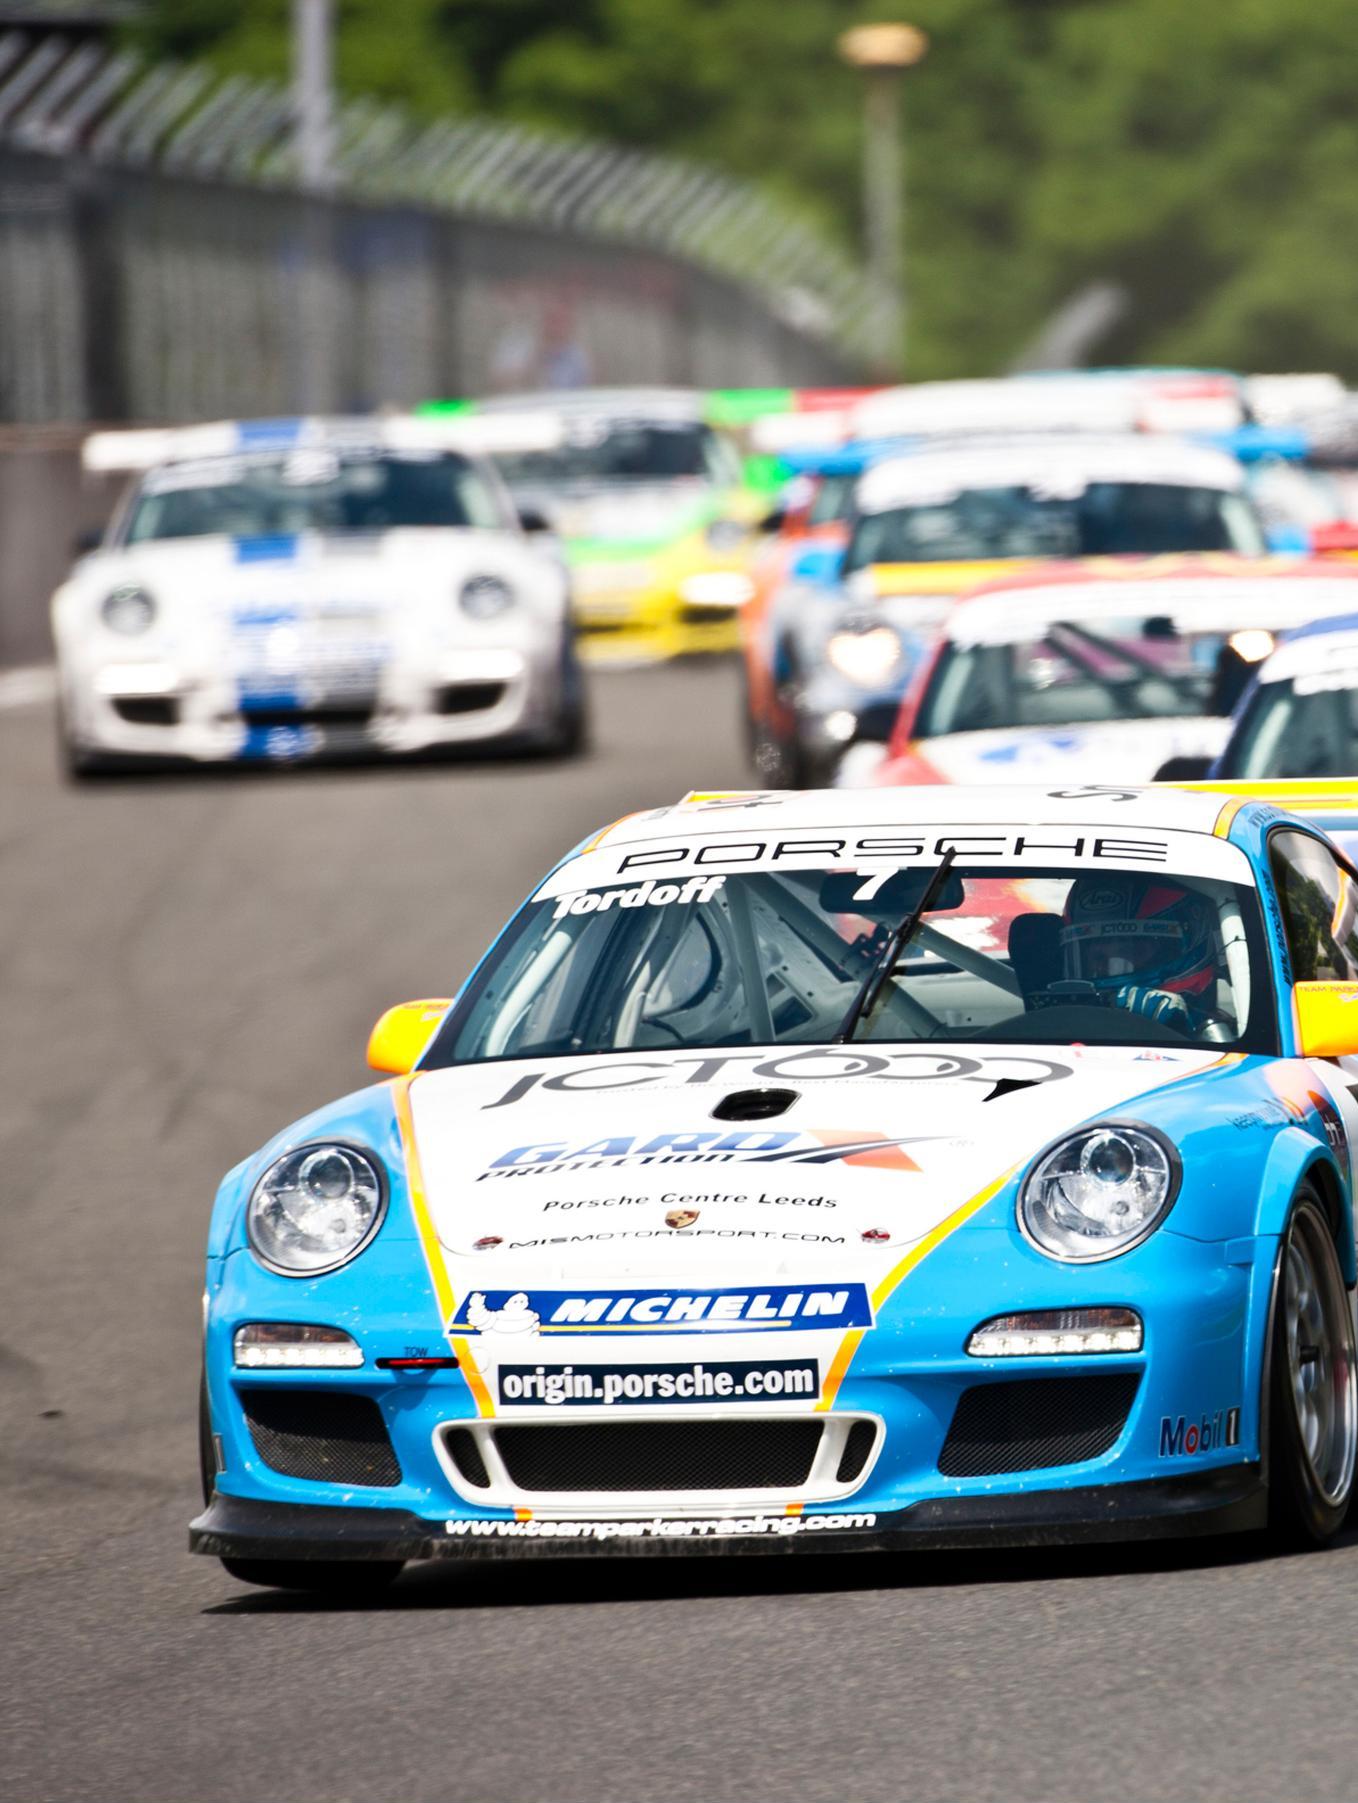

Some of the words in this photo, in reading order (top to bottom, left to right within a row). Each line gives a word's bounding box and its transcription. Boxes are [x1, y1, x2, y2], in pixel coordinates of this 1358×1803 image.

[616, 836, 1169, 874] PORSCHE
[553, 876, 727, 920] Tordoff
[852, 867, 900, 901] 7
[480, 1048, 1074, 1111] JCT600
[475, 1153, 736, 1182] PROTECTION
[542, 1194, 650, 1212] Porsche
[659, 1192, 748, 1204] Centre
[757, 1192, 839, 1209] Leeds
[550, 1291, 850, 1324] MICHELIN
[404, 1347, 429, 1358] TOW
[502, 1364, 814, 1405] origin.porsche.com
[1158, 1409, 1224, 1458] Mobil
[445, 1512, 877, 1538] www.teamparkerracing.com
